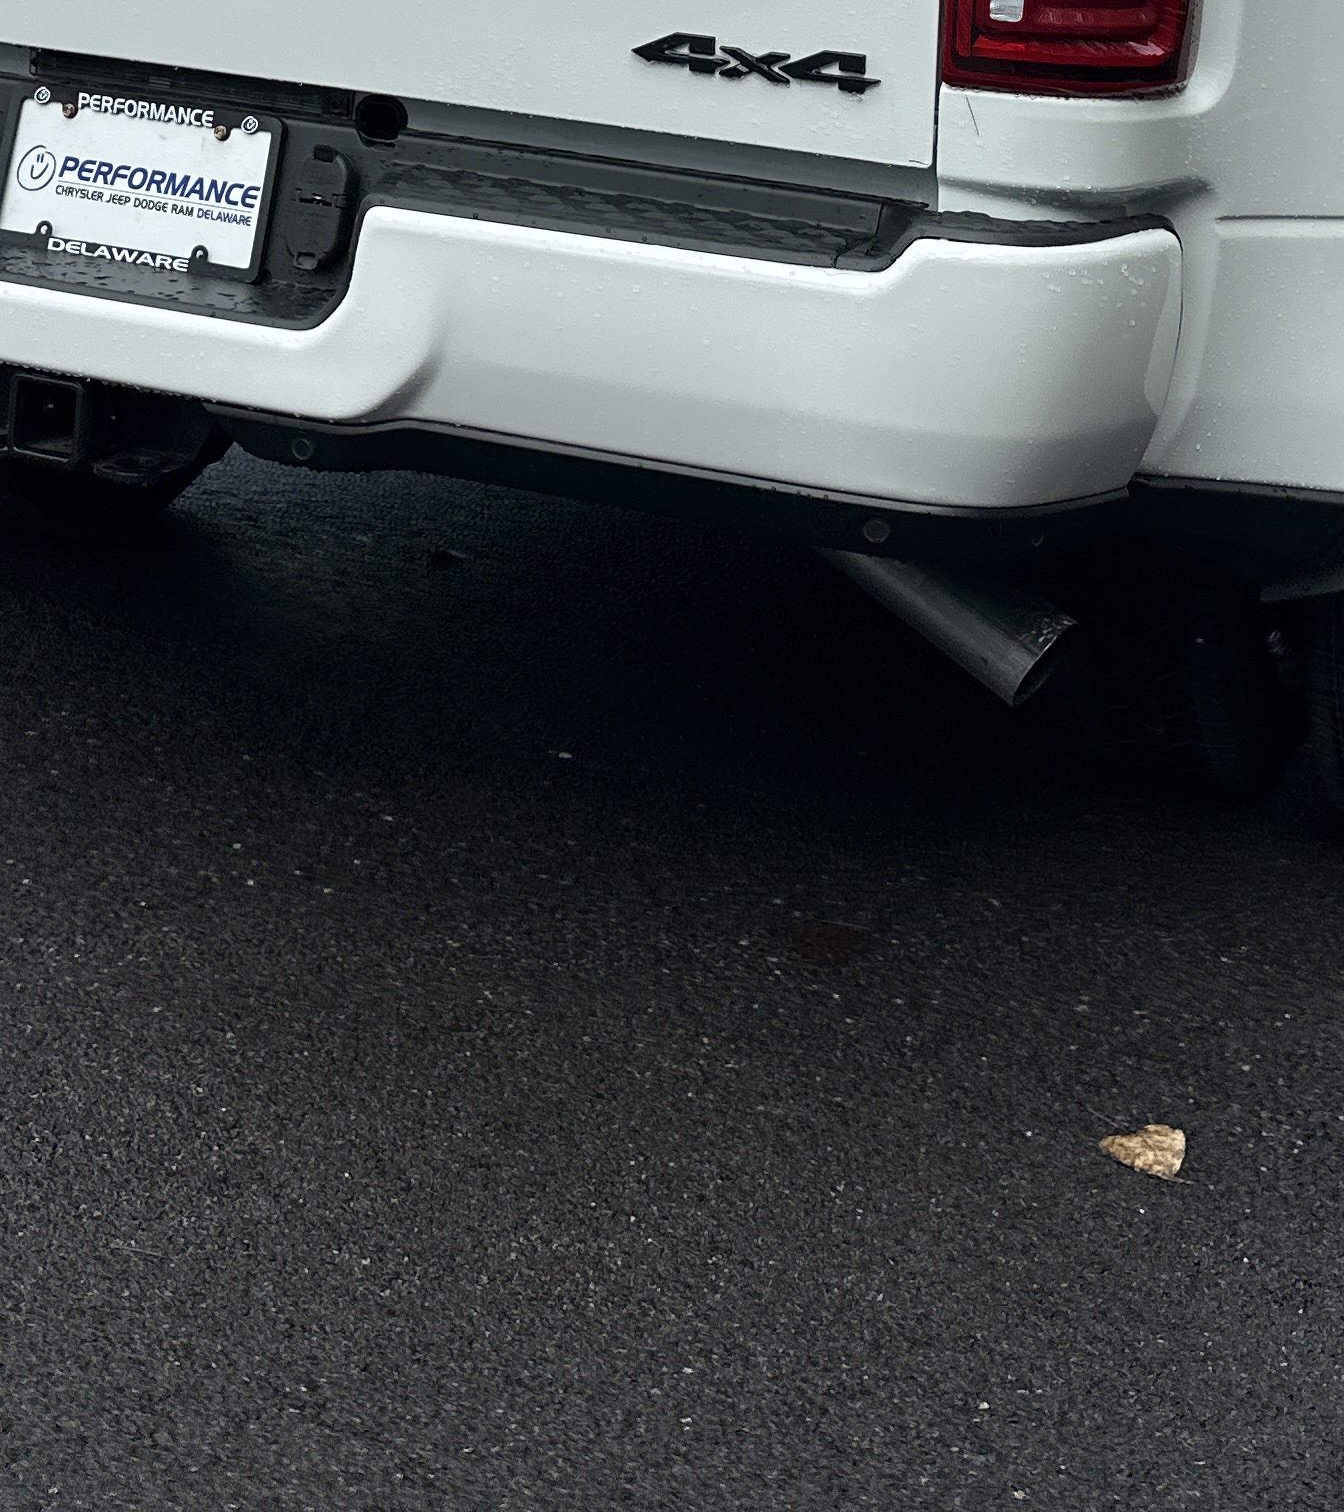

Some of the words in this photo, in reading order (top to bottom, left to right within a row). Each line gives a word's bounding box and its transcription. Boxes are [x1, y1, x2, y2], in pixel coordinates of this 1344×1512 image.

[77, 92, 215, 128] PERFORMANCE
[58, 155, 261, 209] PERFORMANCE
[55, 184, 104, 203] CHRYSLER
[106, 192, 131, 206] JEEP
[133, 197, 169, 213] DODGE
[171, 203, 195, 218] RAM
[197, 208, 253, 227] DELAWARE
[47, 238, 191, 272] DELAWARE
